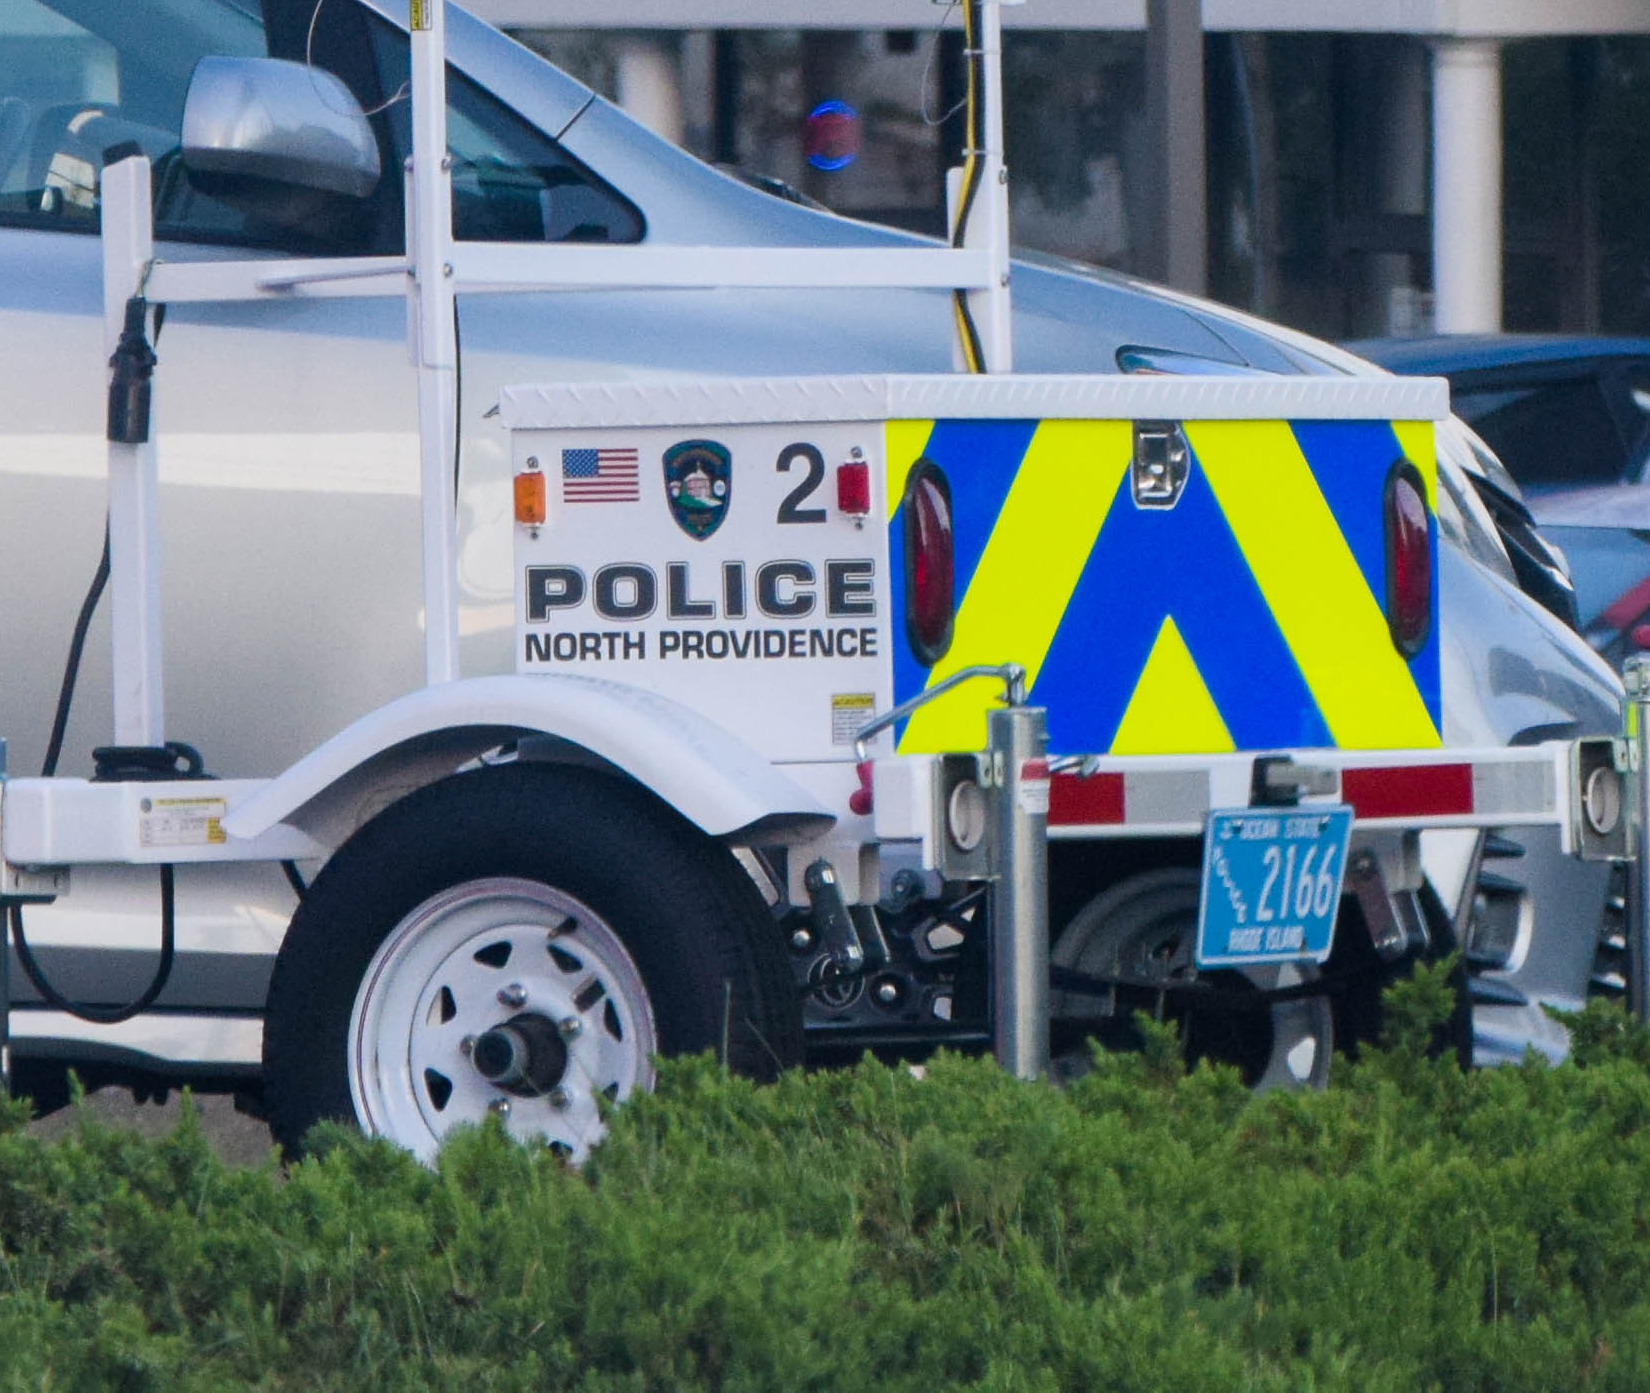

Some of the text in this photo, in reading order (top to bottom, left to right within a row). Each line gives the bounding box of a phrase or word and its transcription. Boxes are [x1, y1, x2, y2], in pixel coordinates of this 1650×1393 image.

[776, 443, 827, 524] 2
[525, 558, 876, 624] POLICE
[525, 627, 877, 662] NORTH PROVIDENCE
[1256, 844, 1336, 922] 2166
